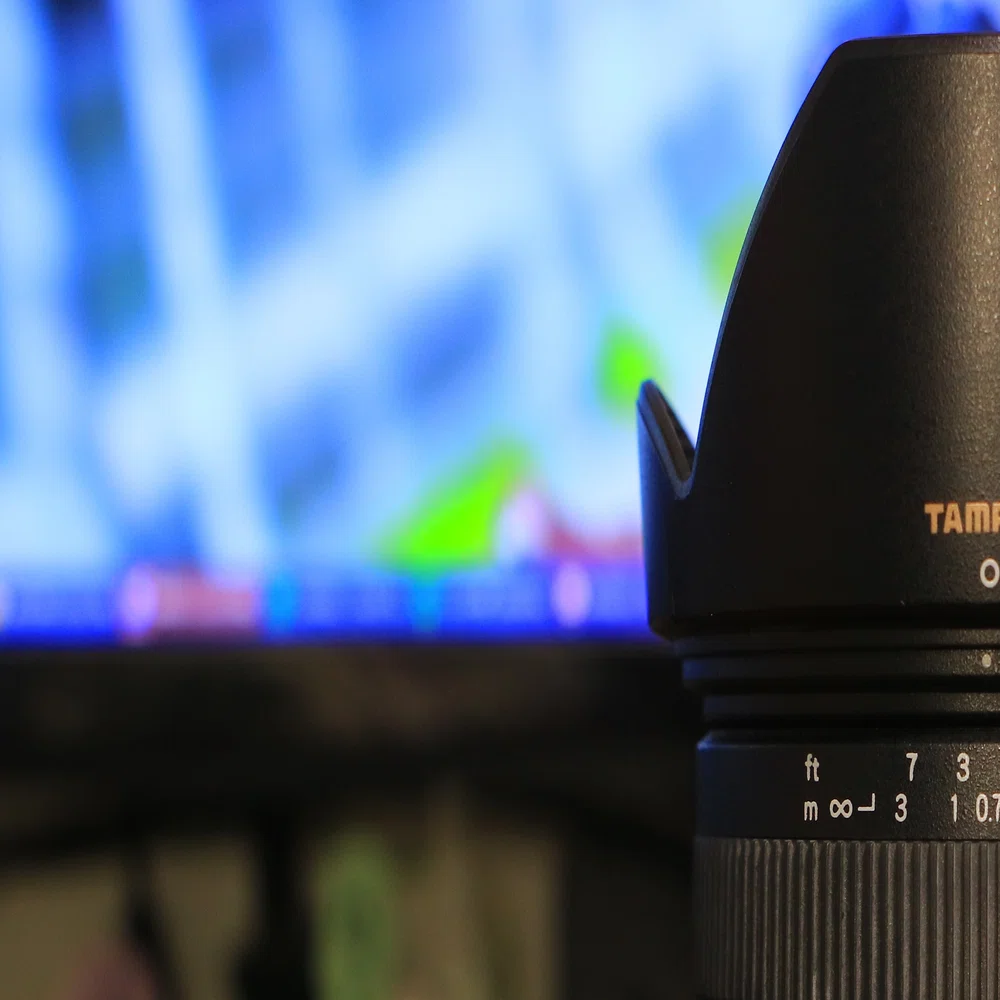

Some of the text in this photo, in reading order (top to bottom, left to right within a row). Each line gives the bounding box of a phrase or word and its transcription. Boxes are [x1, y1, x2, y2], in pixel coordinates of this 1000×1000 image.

[805, 753, 819, 782] ft
[906, 753, 919, 782] 7
[956, 753, 971, 782] 3
[804, 800, 819, 821] m
[895, 794, 908, 822] 3
[951, 794, 958, 822] 1
